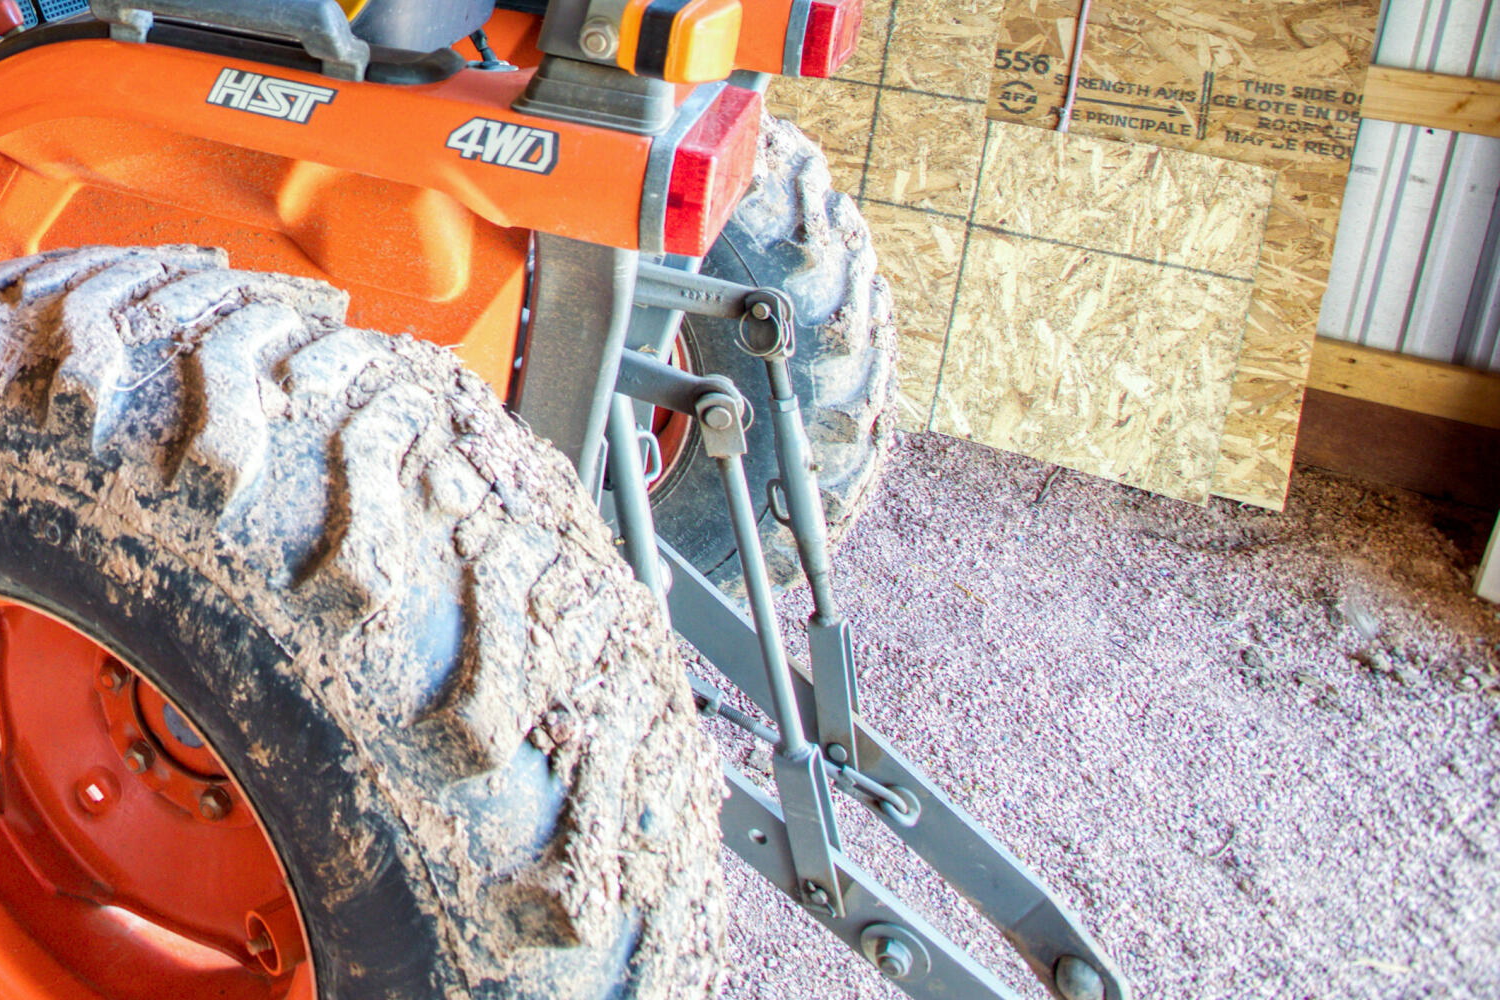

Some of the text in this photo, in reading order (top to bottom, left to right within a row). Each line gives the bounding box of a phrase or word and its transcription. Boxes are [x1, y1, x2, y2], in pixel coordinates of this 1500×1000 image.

[994, 48, 1050, 75] 556
[206, 67, 338, 124] HST
[1054, 74, 1197, 103] SRENGTH AXIS
[1243, 79, 1286, 96] THIS
[1292, 86, 1336, 103] SIDE
[1047, 105, 1192, 137] AE PRINCIPALE
[1212, 94, 1238, 108] CE
[1302, 105, 1330, 120] EN
[446, 116, 559, 175] 4WD
